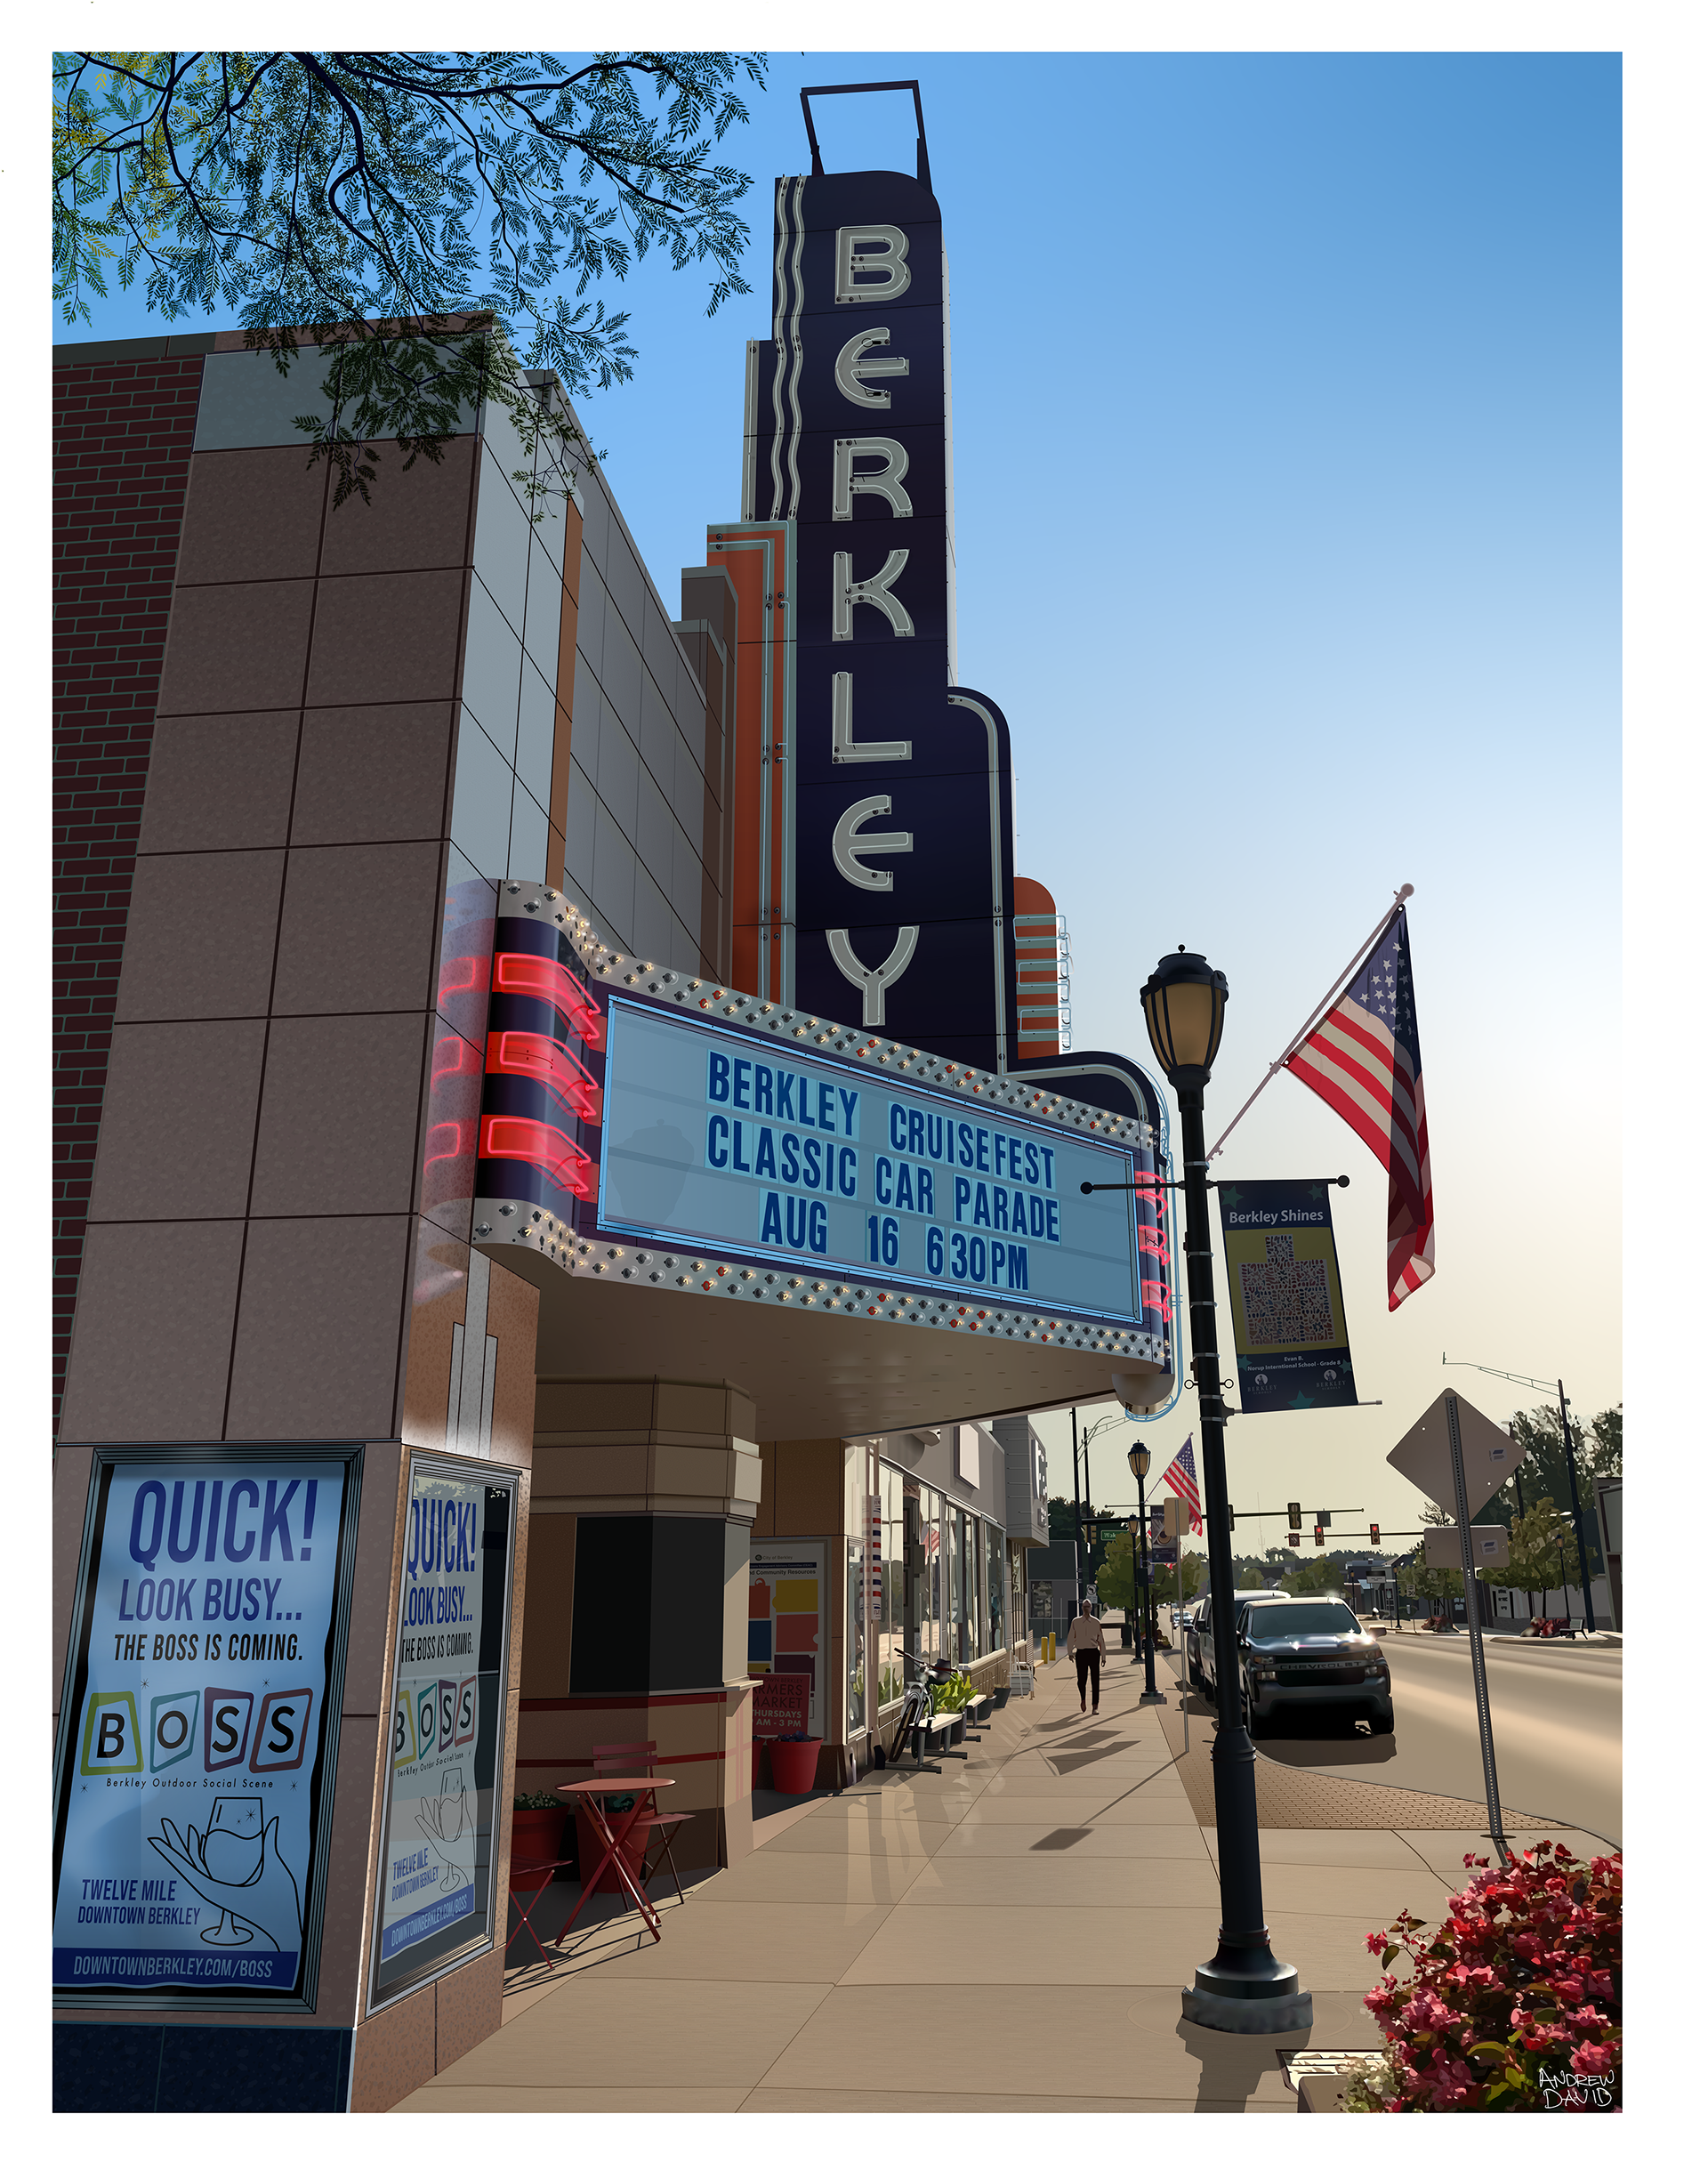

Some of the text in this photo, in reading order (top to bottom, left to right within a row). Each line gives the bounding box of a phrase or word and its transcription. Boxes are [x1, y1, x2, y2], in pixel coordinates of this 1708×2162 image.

[825, 225, 920, 1027] BERKLEY
[709, 1051, 1054, 1190] BERKLEY CRUISEFEST
[708, 1115, 1059, 1242] CLASSIC CAR PARADE
[761, 1191, 827, 1254] AUG
[867, 1214, 898, 1266] 16
[1229, 1209, 1324, 1225] Berkley Shines
[1247, 1384, 1277, 1392] BERKLEY
[1316, 1380, 1346, 1388] BERKLEY
[129, 1479, 318, 1572] QUICK!
[118, 1577, 302, 1622] LOOK BUSY...
[404, 1585, 472, 1626] OOK BUSY...
[114, 1634, 302, 1661] THE BOSS IS COMING.
[417, 1635, 435, 1662] BOSS
[437, 1634, 445, 1658] IS
[1280, 1661, 1361, 1670] CHEVROLET
[753, 1696, 802, 1708] MARKET
[753, 1709, 802, 1718] HURSDAYS
[96, 1706, 295, 1758] BOSS
[398, 1766, 418, 1778] Berkley
[436, 1754, 454, 1765] Social
[106, 1778, 274, 1789] Berkley Outdoor Social Scene
[393, 1853, 416, 1881] TWELVE
[82, 1879, 177, 1901] TWELVE MILE
[391, 1865, 439, 1902] DOWNTOWN BERKLEY
[77, 1906, 201, 1925] DOWNTOWN BERKLEY
[391, 1893, 467, 1947] DOWNTOWNBERKLEY.COM/BOSS
[73, 1956, 273, 1978] DOWNTOWNBERKLEY.COM/BOSS
